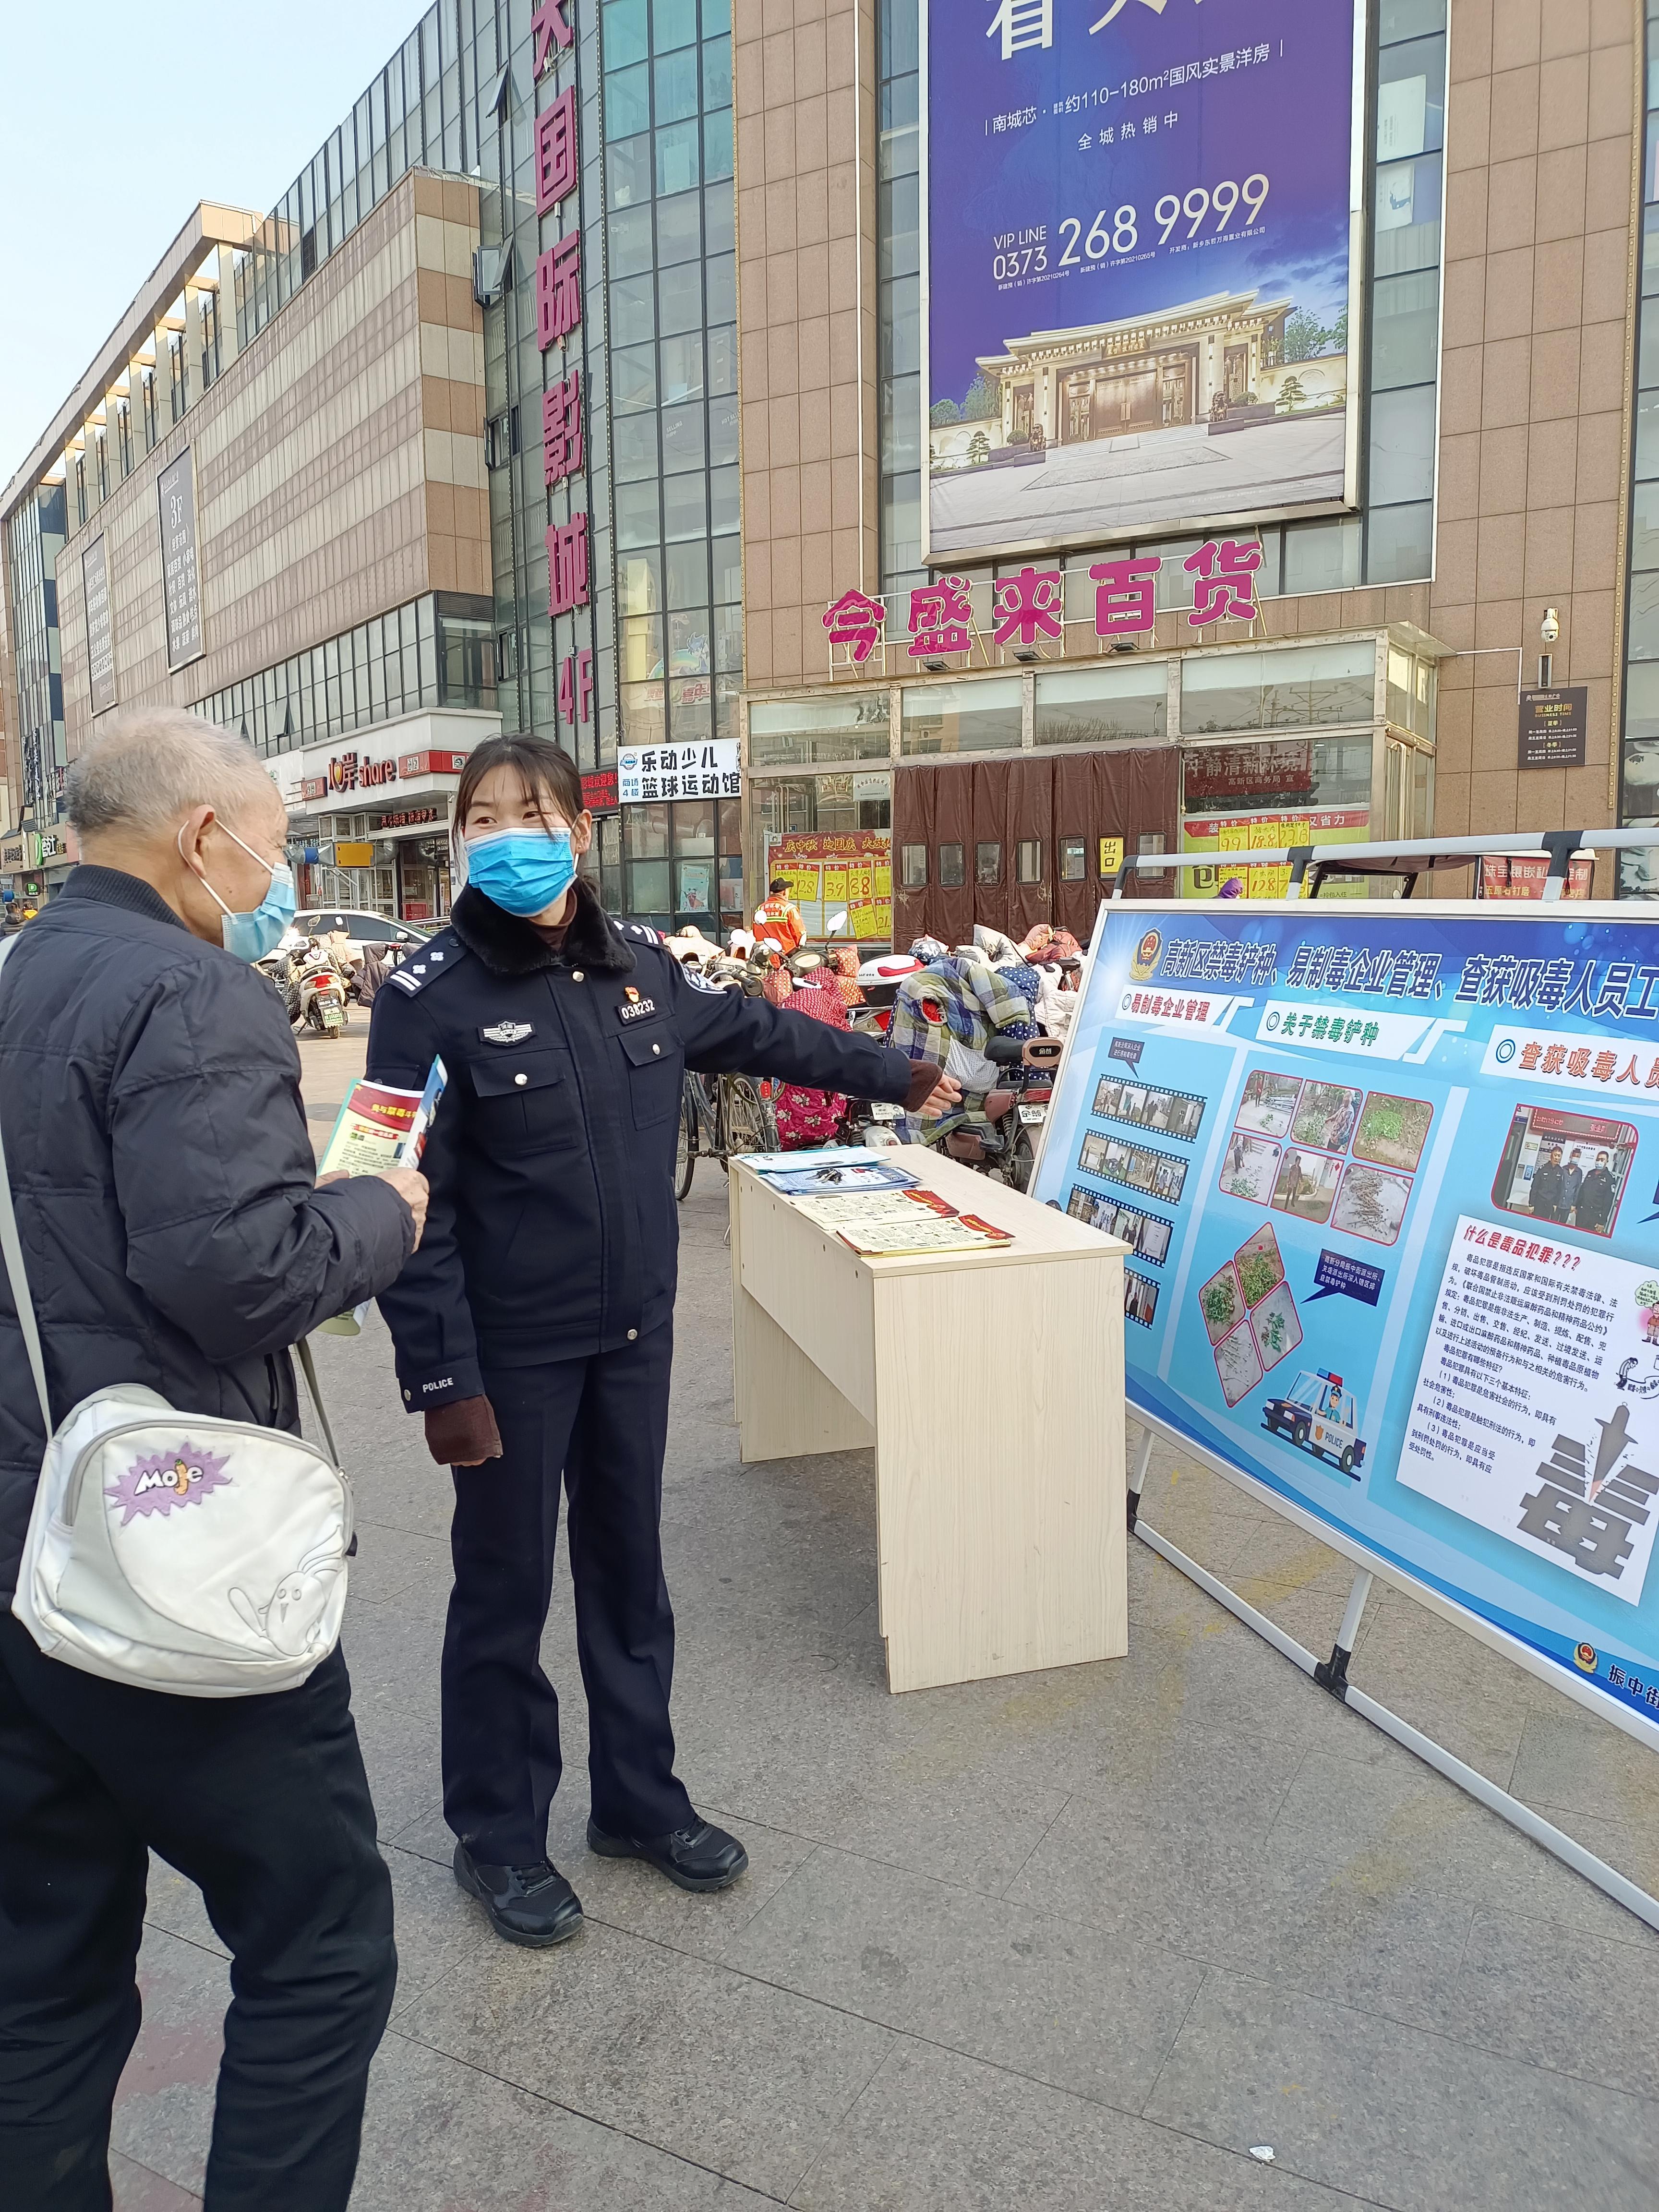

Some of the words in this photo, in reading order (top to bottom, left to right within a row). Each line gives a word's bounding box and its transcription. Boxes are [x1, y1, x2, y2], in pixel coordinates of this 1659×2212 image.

[1078, 110, 1178, 151] 全城热销中
[993, 245, 1047, 280] 0373
[1058, 204, 1138, 267] 268
[1154, 173, 1270, 245] 9999
[993, 232, 1015, 250] VIP
[1018, 225, 1047, 245] LINE
[170, 495, 183, 529] 3F
[820, 539, 1263, 663] 今盛来百货
[1535, 703, 1573, 713] 营业时间
[358, 756, 397, 787] share
[642, 746, 718, 772] 乐动少儿
[622, 778, 638, 787] 商场
[642, 772, 742, 798] 篮球运动馆
[1228, 775, 1280, 785] 高新区商务局
[1286, 774, 1295, 782] 宣
[784, 839, 818, 852] 庆中秋
[823, 837, 857, 851] 迎国庆
[1104, 841, 1116, 867] 出口
[826, 882, 844, 897] 3.9
[621, 999, 656, 1020] 038232
[1129, 993, 1211, 1022] 易制毒企业管理
[1280, 1011, 1380, 1046] 关于禁毒铲种
[422, 1377, 454, 1393] POLICE
[1325, 1431, 1344, 1449] POLICE
